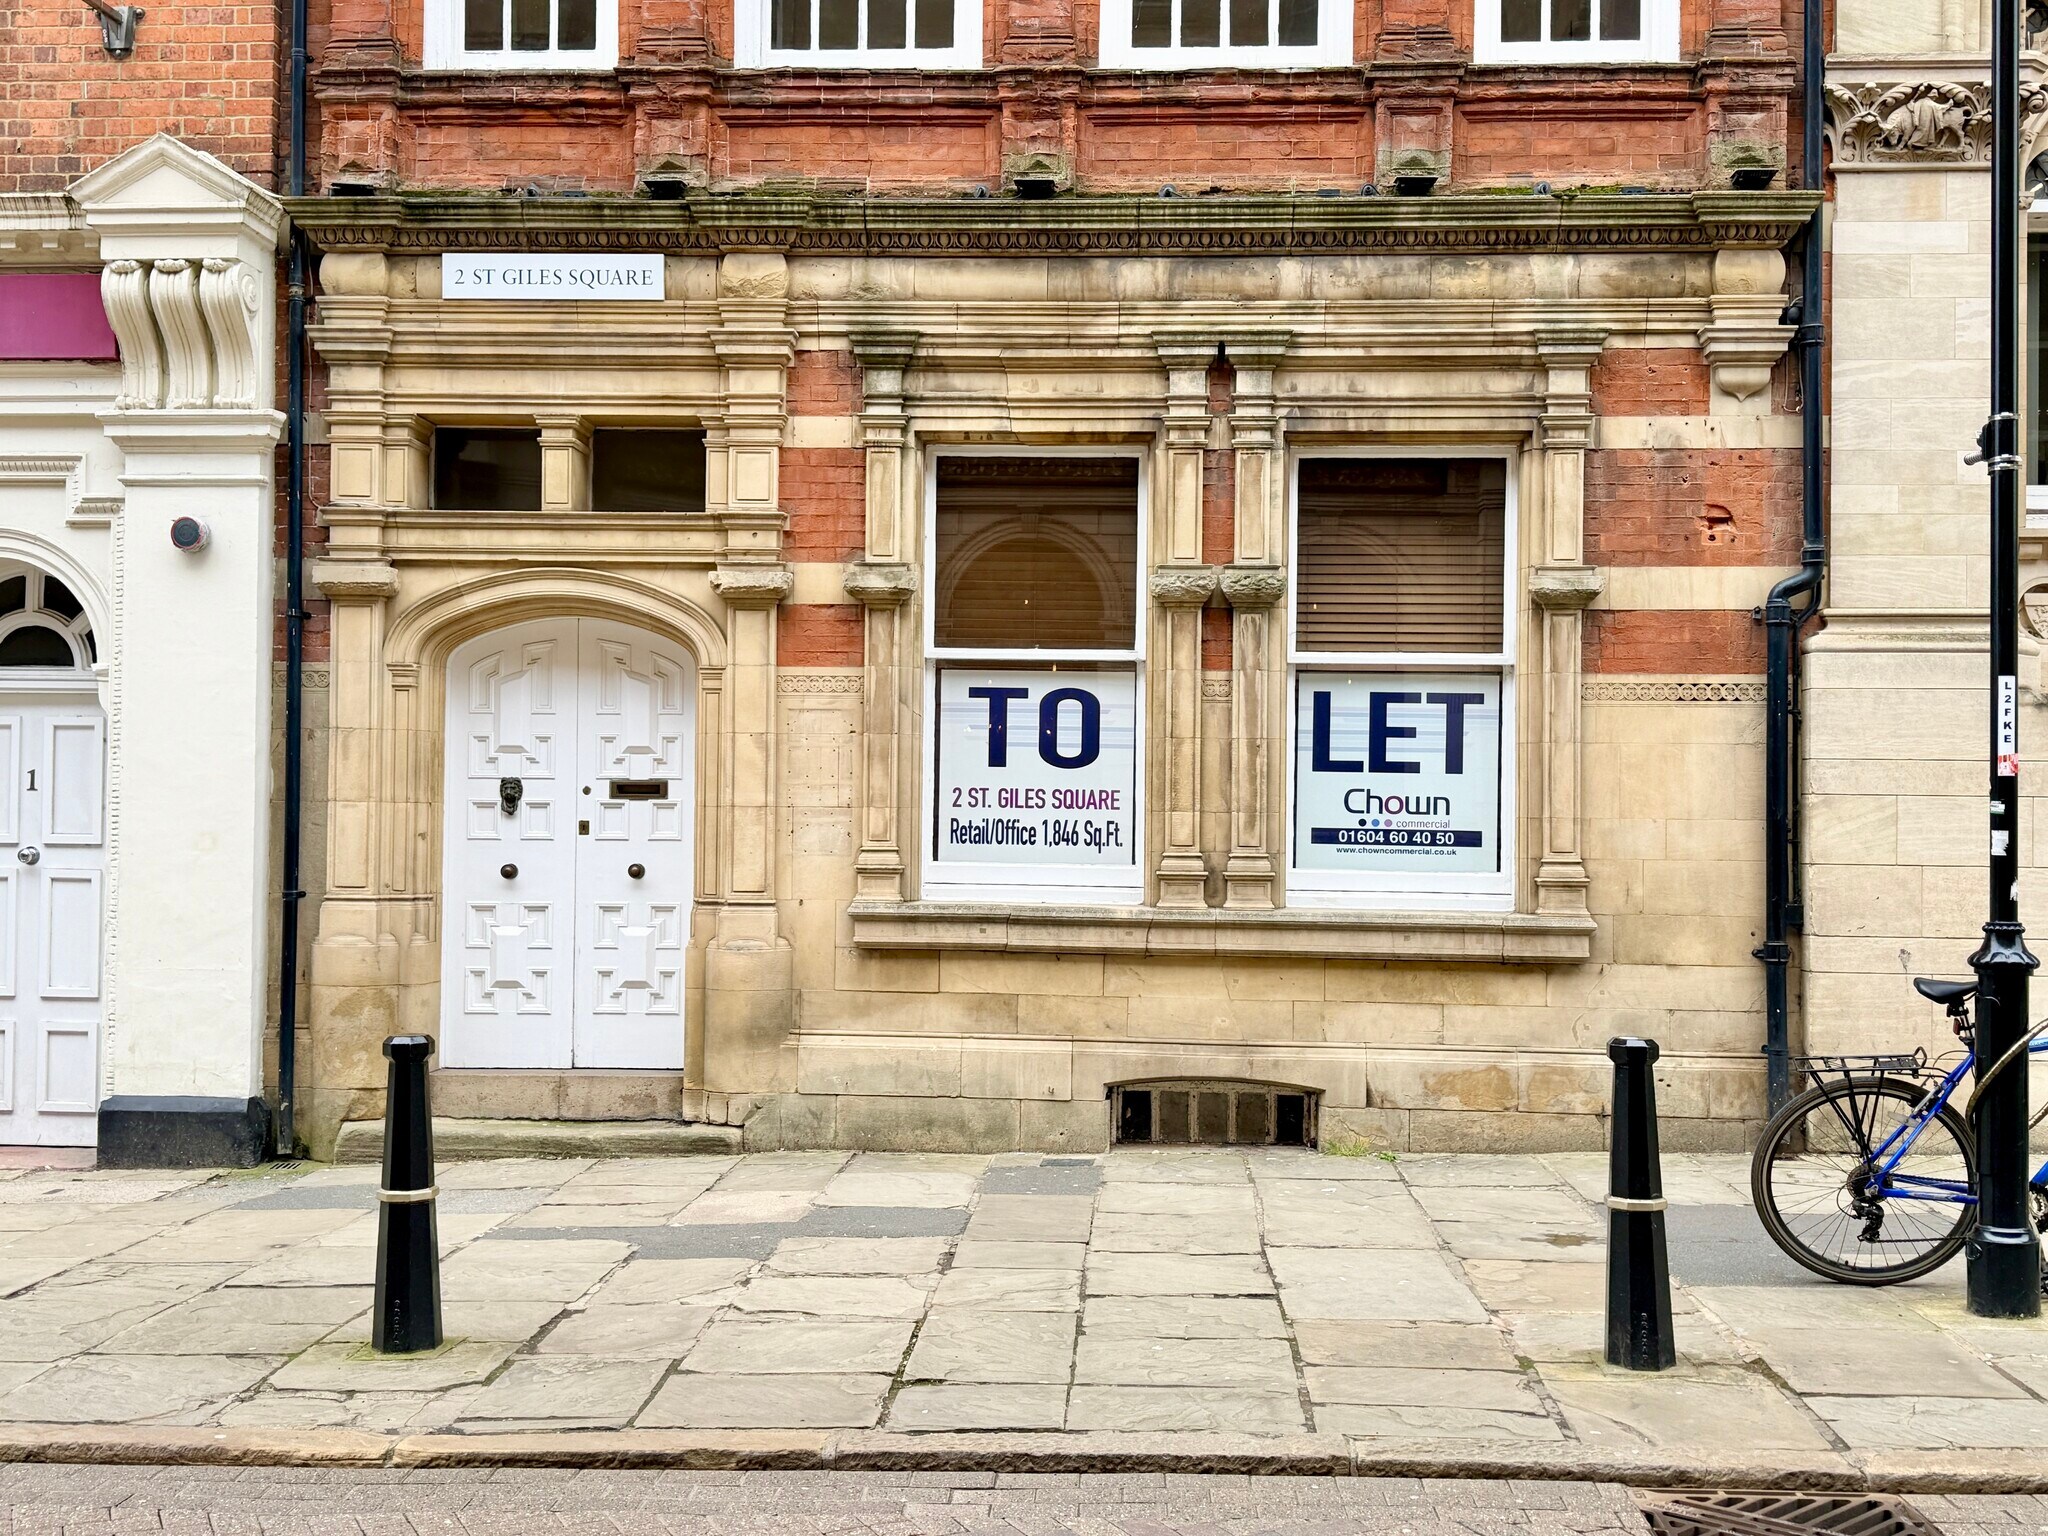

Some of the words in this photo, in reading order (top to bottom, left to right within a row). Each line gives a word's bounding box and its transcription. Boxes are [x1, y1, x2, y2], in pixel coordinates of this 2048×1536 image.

[454, 268, 465, 285] 2
[473, 268, 496, 285] ST
[502, 268, 562, 285] GILES
[568, 269, 653, 289] SQUARE
[968, 686, 1101, 770] TO
[1311, 690, 1485, 775] LET
[26, 768, 38, 792] 1
[952, 787, 963, 808] 2
[967, 787, 992, 809] ST.
[997, 787, 1047, 809] GILES
[1051, 788, 1121, 811] SQUARE
[1343, 788, 1451, 816] Chown
[950, 817, 1037, 846] Retail/Office
[1041, 819, 1079, 848] 1,846
[1083, 820, 1123, 854] Sq.Ft.
[1395, 819, 1451, 829] commercial
[1338, 829, 1385, 844] 01604
[1389, 830, 1408, 844] 60
[1412, 831, 1432, 845] 40
[1435, 832, 1455, 846] 50
[1336, 847, 1457, 856] www.chowncommercial.co.uk
